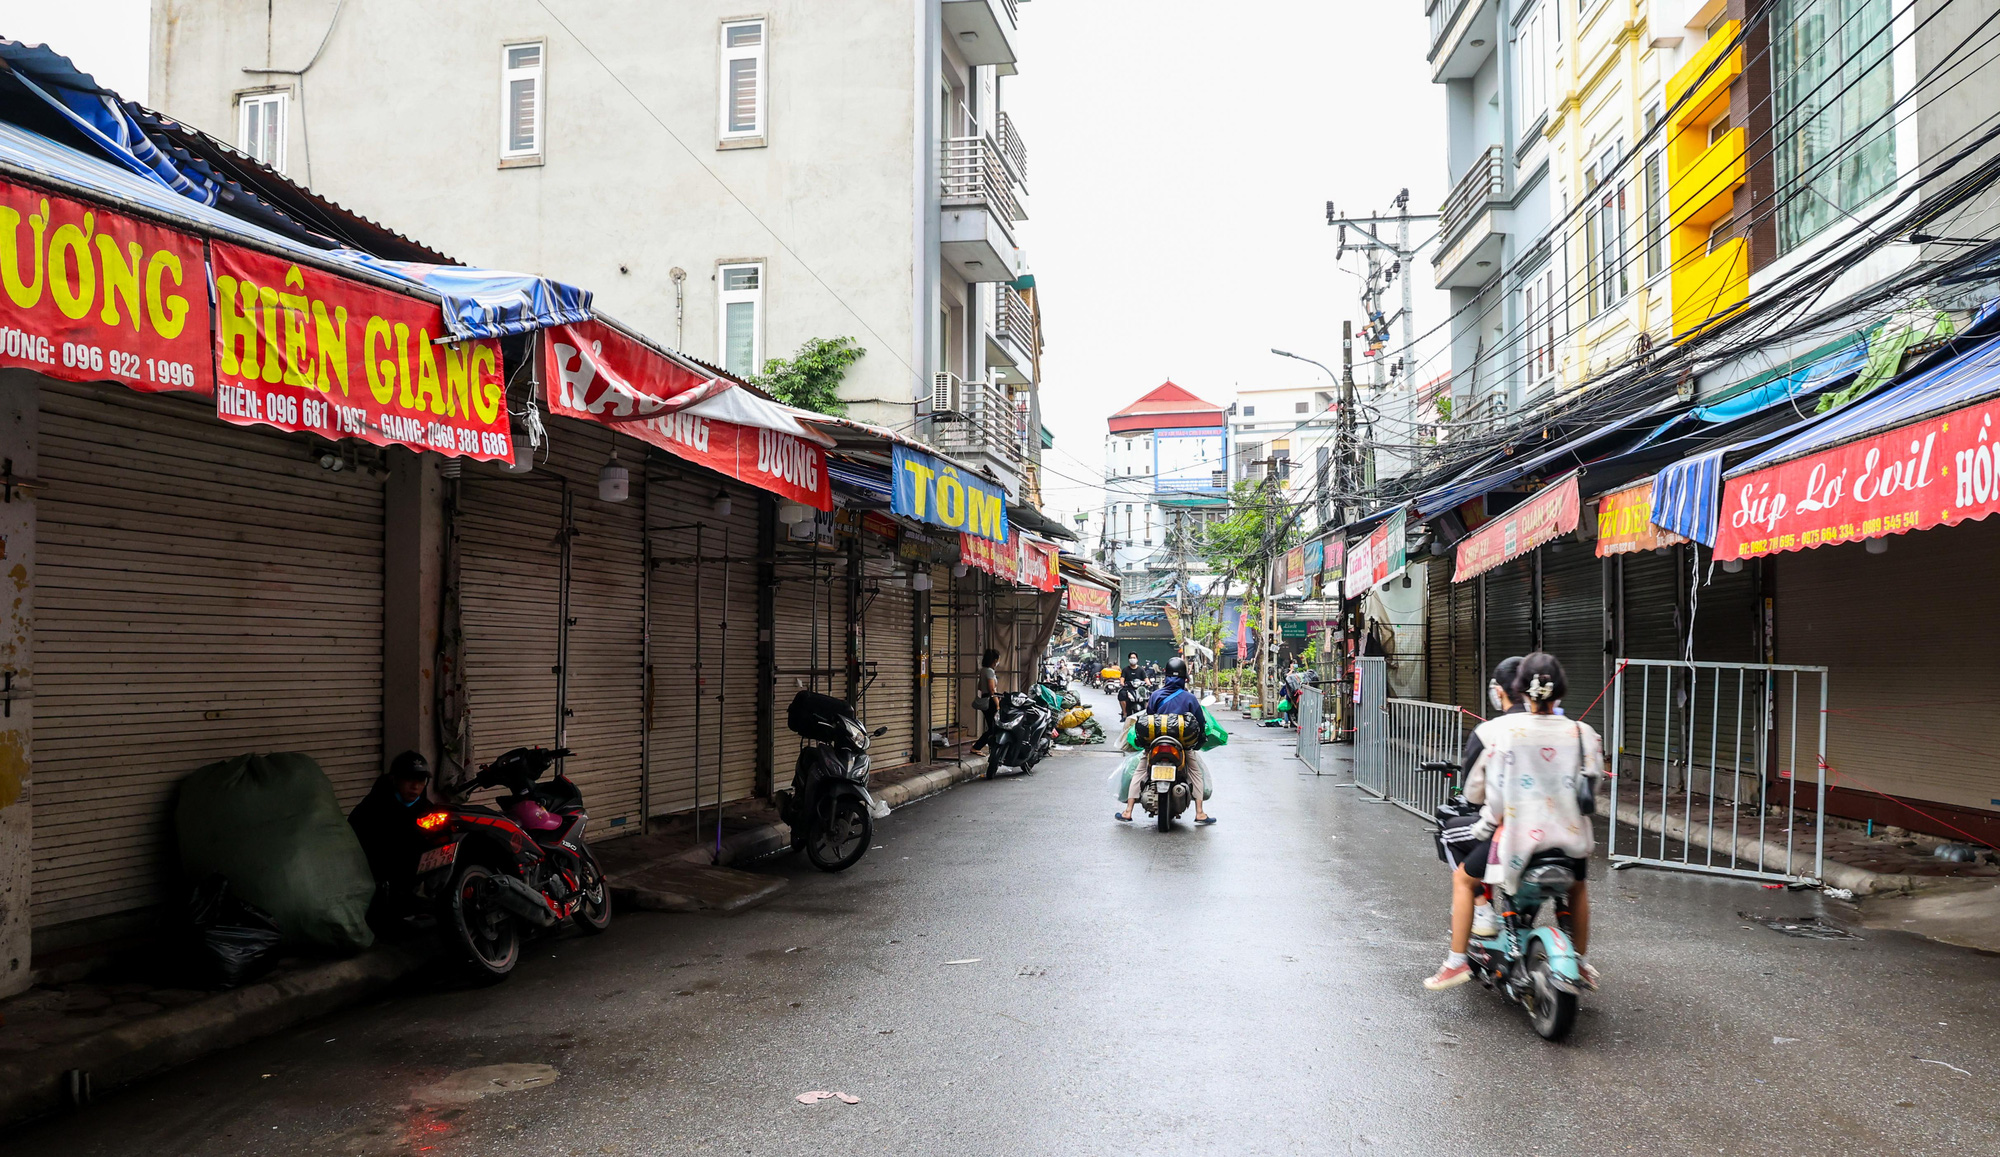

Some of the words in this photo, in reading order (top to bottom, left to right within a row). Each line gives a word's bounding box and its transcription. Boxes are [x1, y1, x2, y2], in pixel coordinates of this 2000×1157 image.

[62, 342, 103, 372] 096
[109, 350, 141, 379] 922
[146, 358, 195, 387] 1996
[217, 263, 349, 397] HIÊN
[364, 315, 501, 425] GIANG
[219, 382, 262, 419] HIÊN:
[266, 393, 297, 425] 096
[302, 398, 328, 430] 681
[335, 404, 367, 436] 1997
[381, 413, 425, 444] GIANG:
[427, 422, 454, 450] 0969
[457, 428, 479, 454] 388
[481, 431, 508, 456] 686
[905, 459, 1003, 541] TÔM
[1732, 482, 1788, 533] Súp
[1796, 463, 1847, 515] Lơ
[1780, 533, 1795, 548] 695
[1801, 529, 1820, 545] 0975
[1821, 527, 1838, 543] 664
[1839, 523, 1855, 539] 334
[1883, 513, 1902, 531] 545
[1903, 510, 1919, 527] 541
